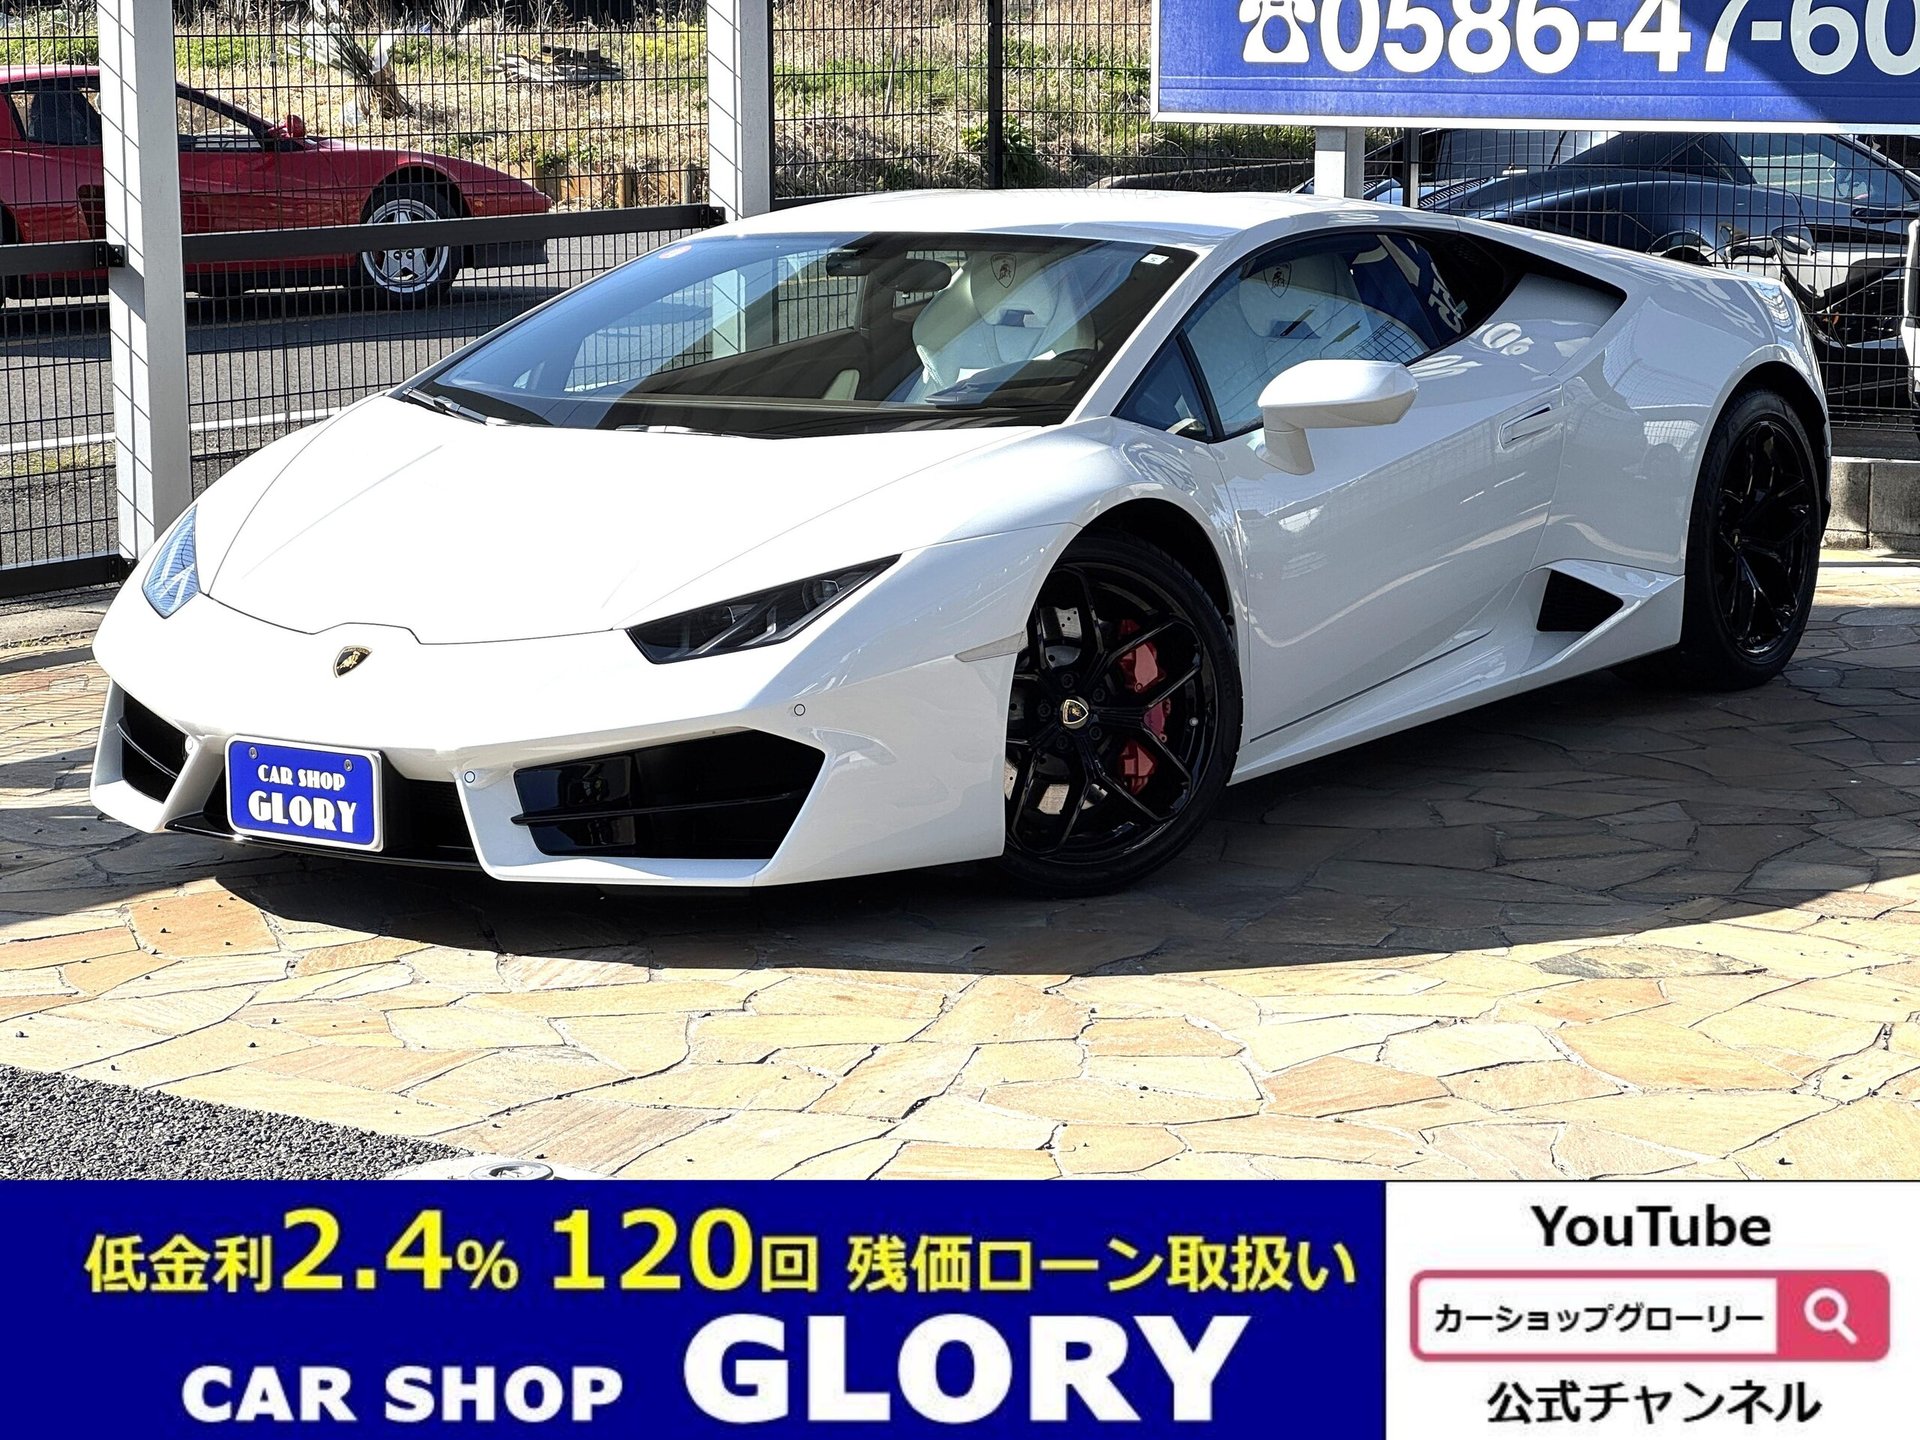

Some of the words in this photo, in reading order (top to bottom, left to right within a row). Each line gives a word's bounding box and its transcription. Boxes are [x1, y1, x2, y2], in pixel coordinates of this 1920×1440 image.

[257, 764, 294, 786] CAR
[297, 768, 346, 792] SHOP
[247, 790, 357, 834] GLORY
